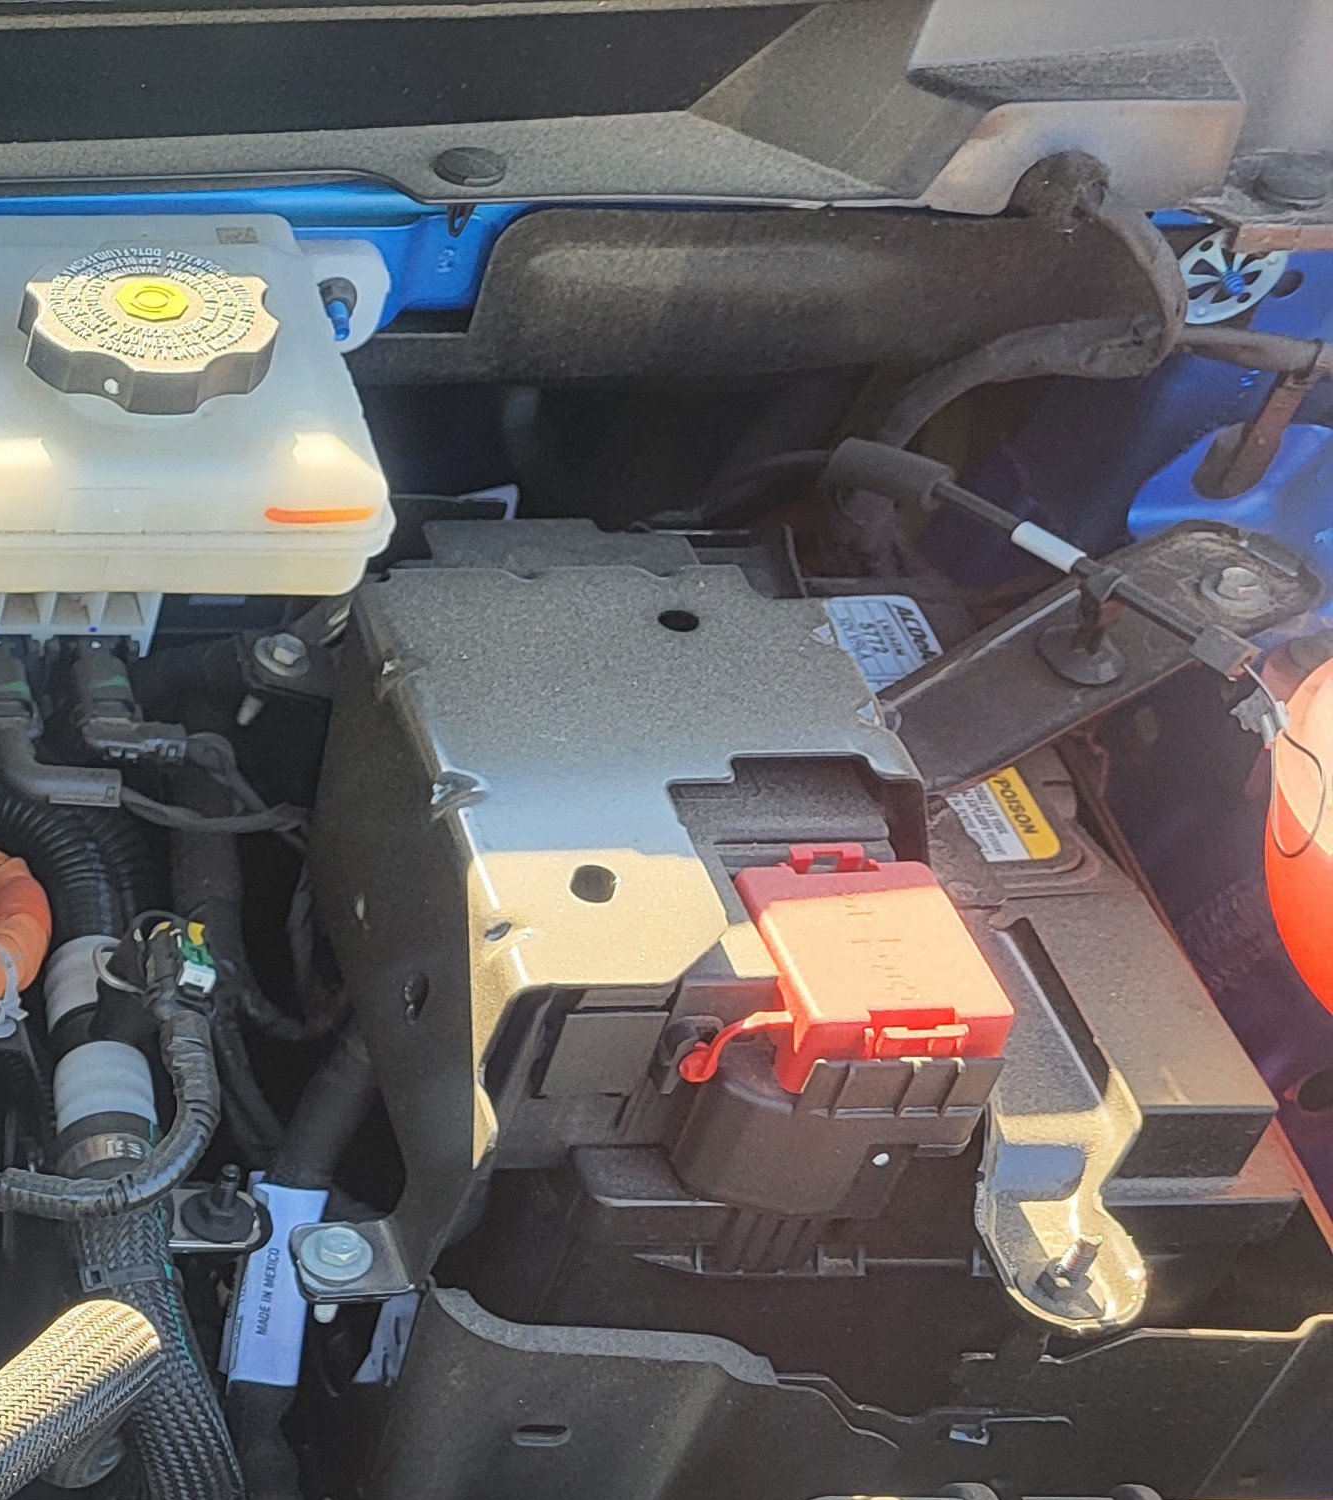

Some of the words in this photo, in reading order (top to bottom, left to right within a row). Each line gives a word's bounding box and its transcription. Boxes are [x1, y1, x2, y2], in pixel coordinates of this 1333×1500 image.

[993, 778, 1039, 835] POISON
[263, 1247, 281, 1288] MEXICO
[260, 1289, 273, 1304] IN
[255, 1304, 271, 1336] MADE
